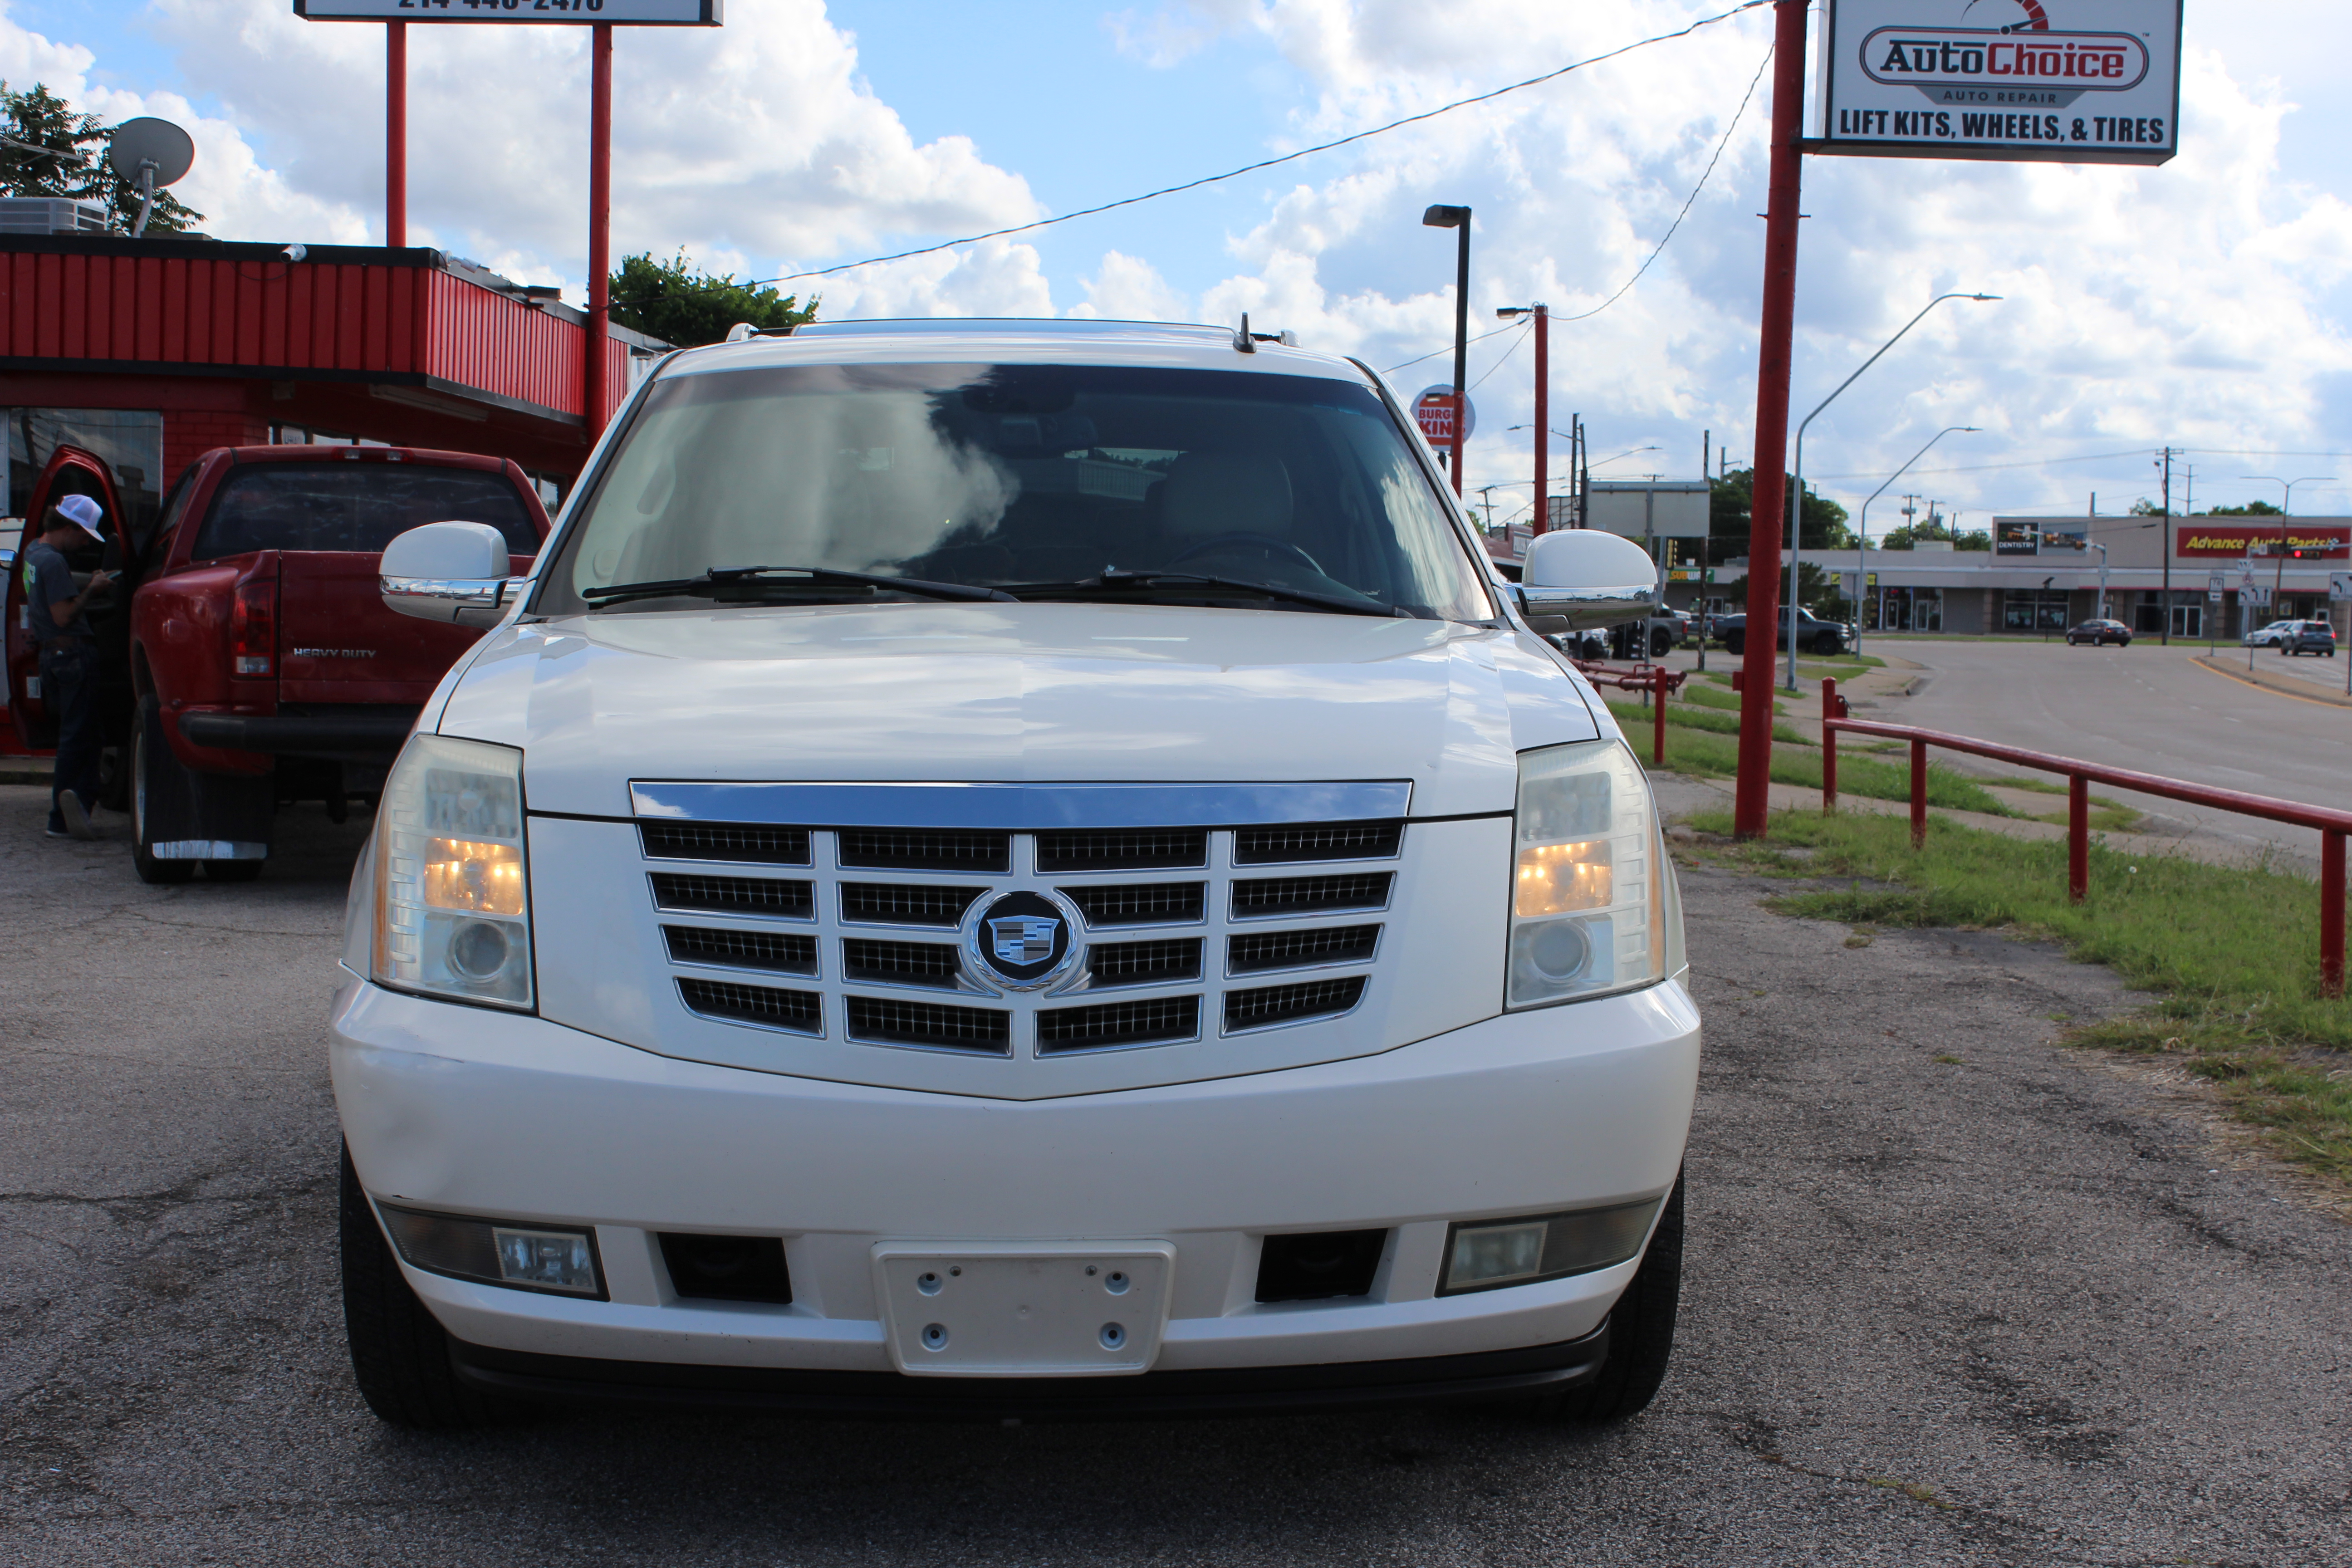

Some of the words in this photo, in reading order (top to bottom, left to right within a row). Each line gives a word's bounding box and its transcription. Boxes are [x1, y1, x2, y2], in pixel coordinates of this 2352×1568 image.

[1880, 39, 2127, 78] AutoChoice
[1943, 90, 1989, 102] AUTO
[1997, 92, 2056, 103] REPAIR
[1840, 108, 1889, 135] LIFT
[1894, 110, 1956, 140] KITS,
[1962, 112, 2065, 143] WHEELS,
[2070, 118, 2088, 142] &
[2093, 116, 2164, 143] TIRES
[1418, 409, 1465, 420] BURG
[1418, 421, 1465, 436] KIN
[2185, 535, 2246, 549] Advance
[294, 648, 339, 658] HEAVY
[342, 649, 377, 658] DUTY
